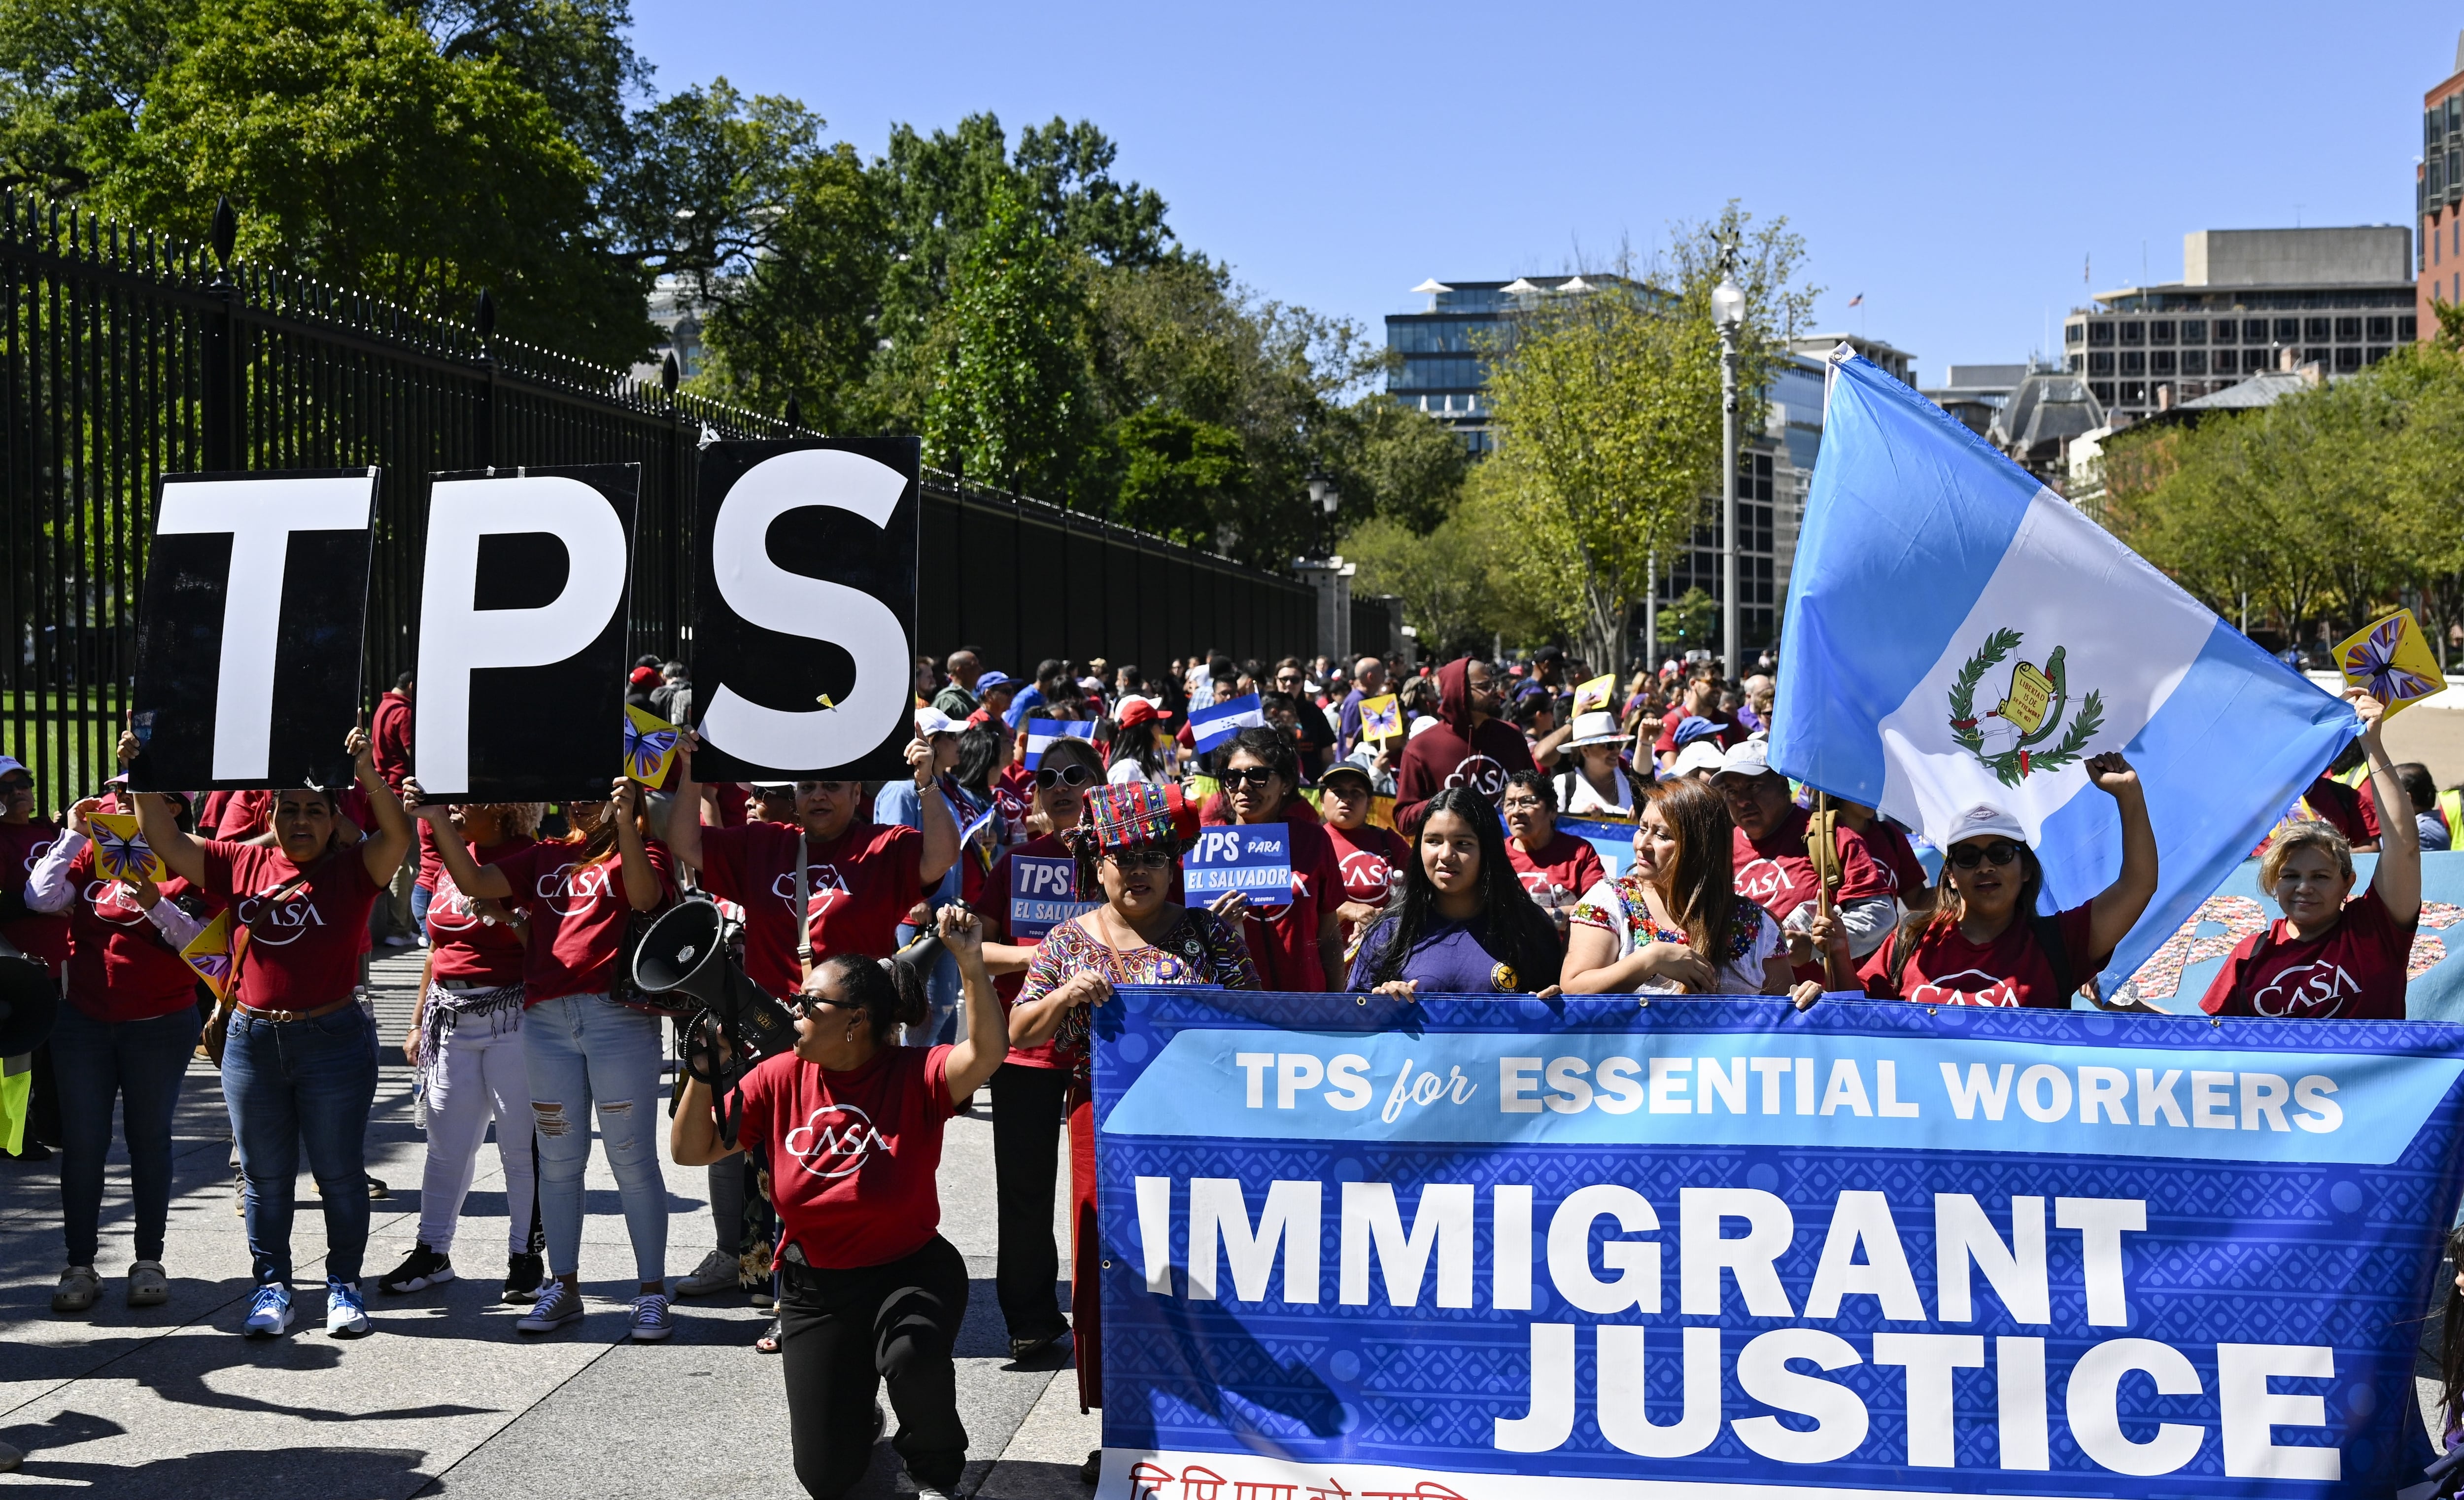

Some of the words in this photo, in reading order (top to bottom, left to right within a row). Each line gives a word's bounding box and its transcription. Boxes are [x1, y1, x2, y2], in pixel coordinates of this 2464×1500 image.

[2019, 679, 2045, 701] LIBERTAD
[2029, 698, 2038, 708] DE
[2012, 697, 2041, 720] SEPTIEMBRE
[1192, 832, 1240, 863] TPS
[1247, 840, 1281, 853] PARA
[537, 871, 616, 898] CASA
[1020, 863, 1069, 895] TPS
[1188, 872, 1204, 889] EL
[1209, 869, 1288, 888] SALVADOR
[1015, 902, 1030, 918] EL
[2254, 965, 2362, 1017] CASA
[756, 1014, 771, 1028] UZI
[1236, 1053, 1372, 1111] TPS
[1381, 1058, 1478, 1124] for
[1500, 1056, 1919, 1118] ESSENTIAL
[1939, 1062, 2344, 1134] WORKERS
[785, 1123, 892, 1156] CASA
[1134, 1176, 2147, 1327] IMMIGRANT
[1494, 1323, 2341, 1481] JUSTICE
